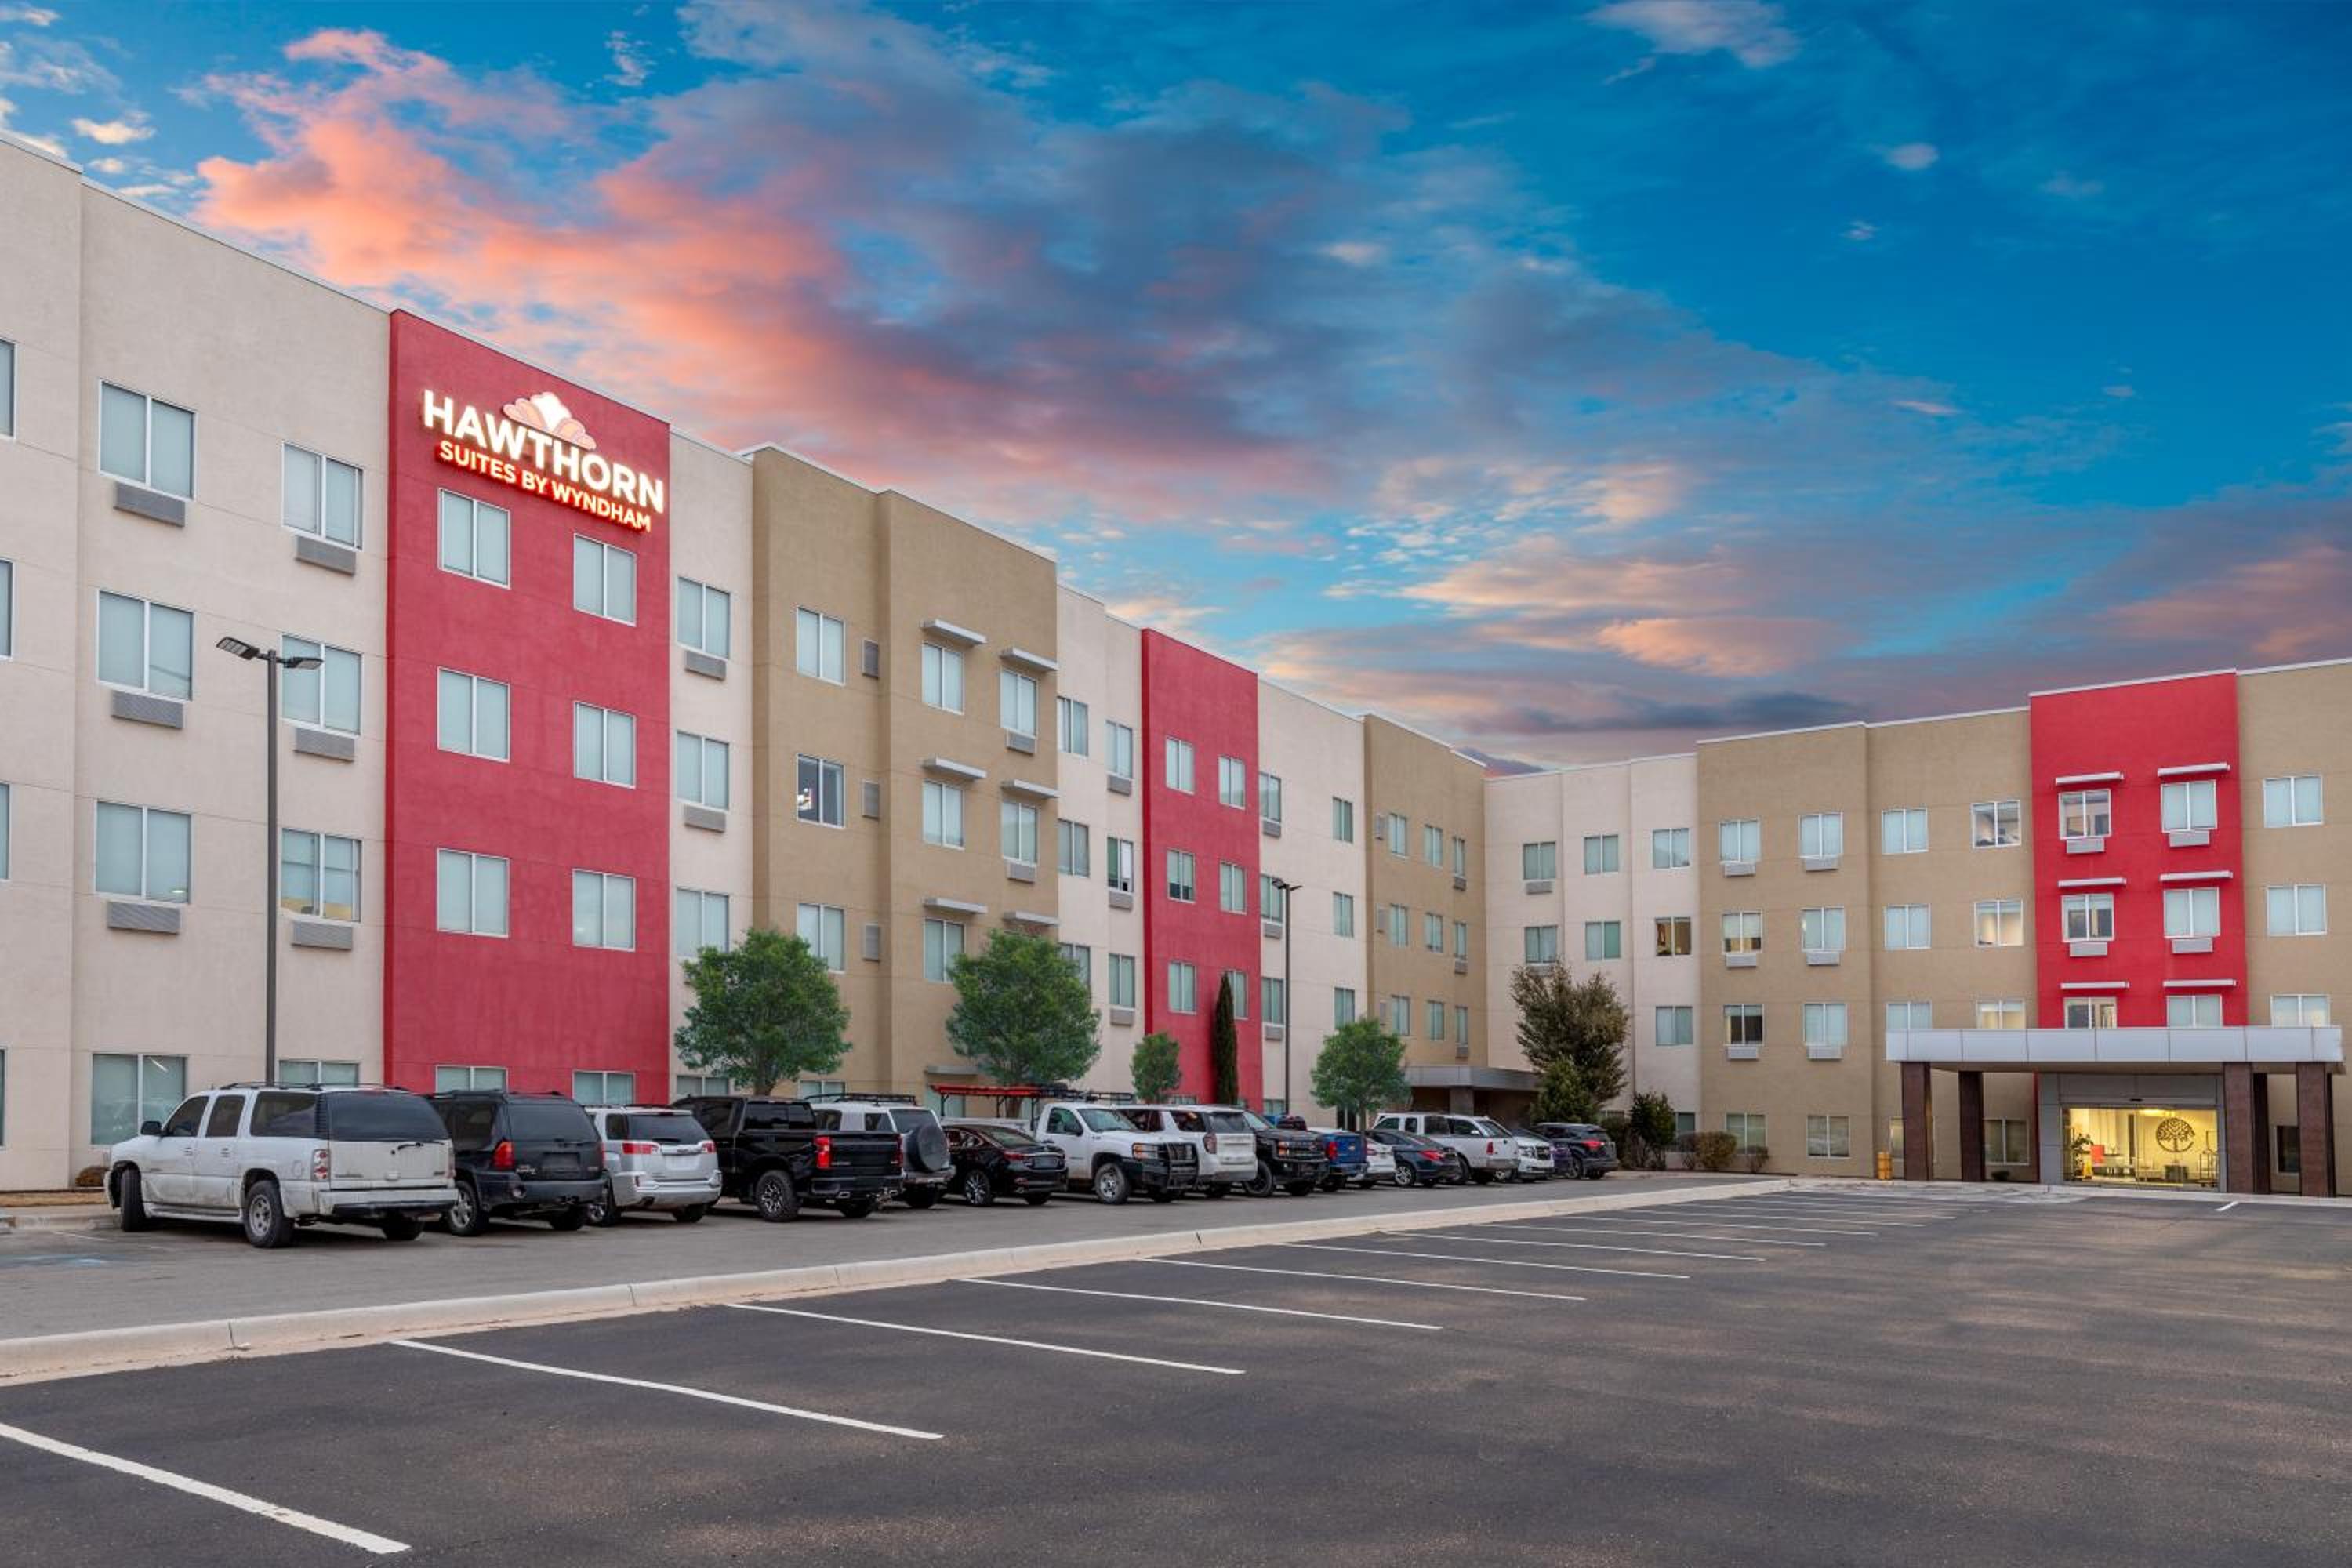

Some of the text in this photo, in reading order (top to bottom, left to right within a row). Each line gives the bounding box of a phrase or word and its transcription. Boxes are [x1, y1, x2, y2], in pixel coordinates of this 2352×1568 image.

[423, 390, 664, 514] HAWTHORN
[439, 440, 652, 532] SUITES BY WYNDHAM
